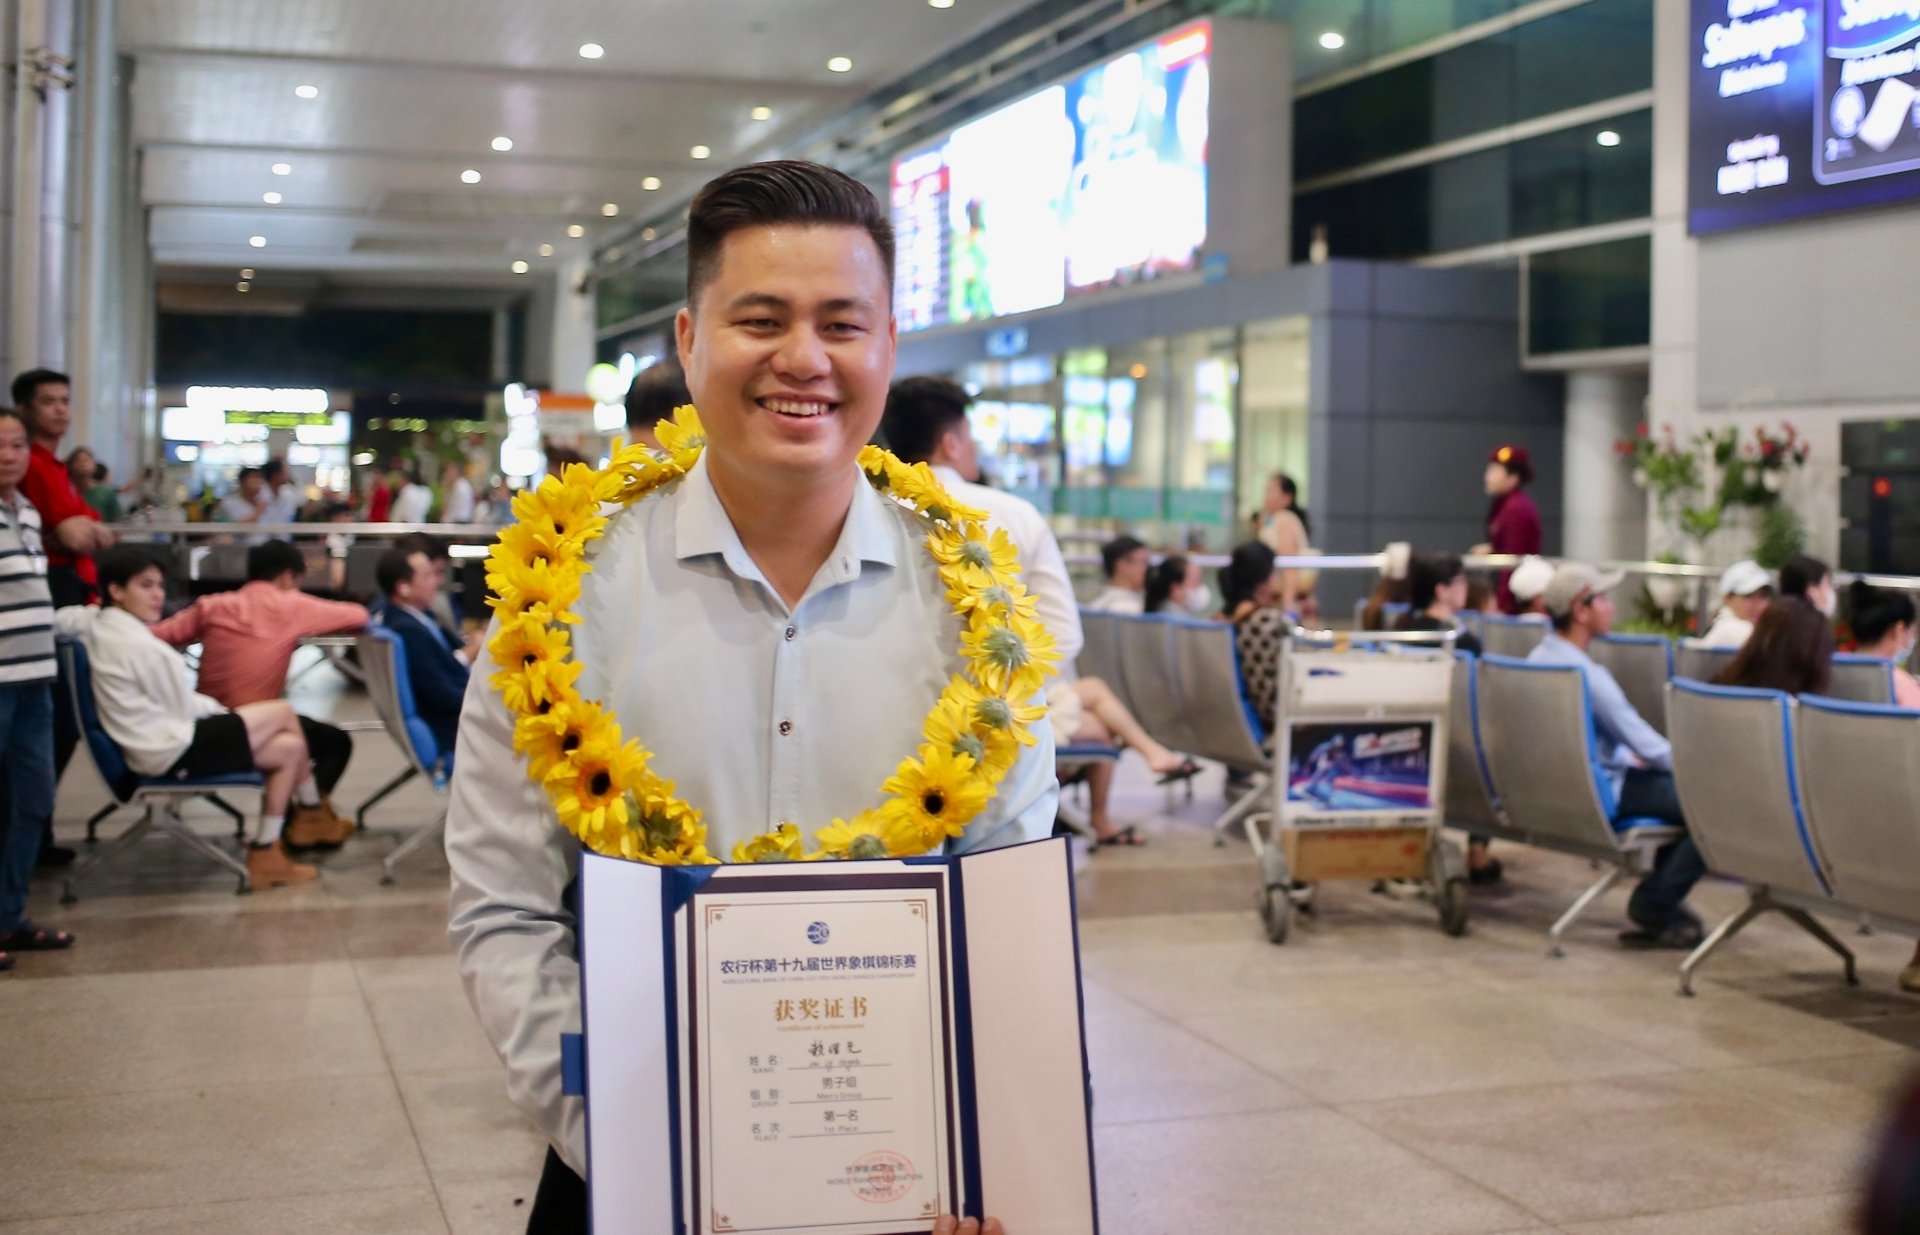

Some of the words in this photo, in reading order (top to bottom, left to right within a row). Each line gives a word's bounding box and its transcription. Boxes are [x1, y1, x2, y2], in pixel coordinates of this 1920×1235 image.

[721, 954, 917, 974] 农行杯第十九届世界象棋锦标赛
[775, 996, 867, 1021] 获奖证书
[822, 1075, 858, 1089] 男子组
[824, 1109, 859, 1121] 第一名
